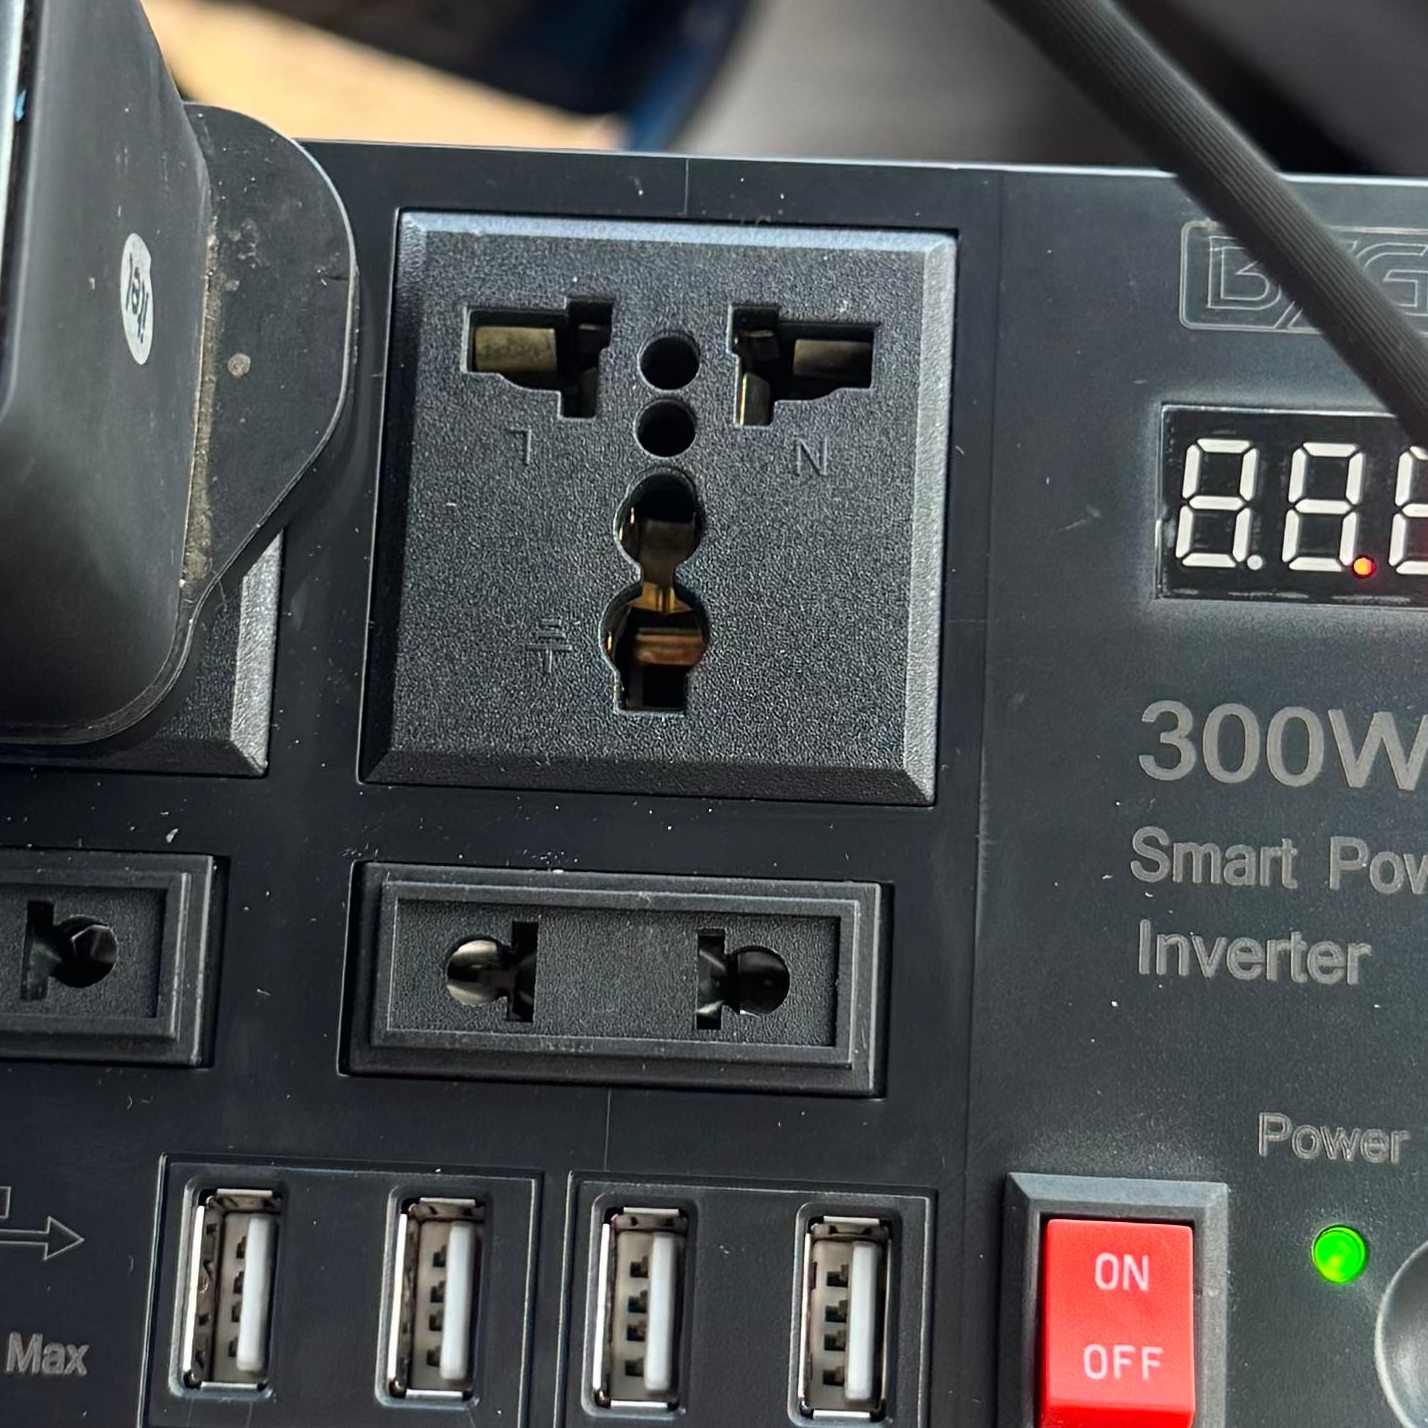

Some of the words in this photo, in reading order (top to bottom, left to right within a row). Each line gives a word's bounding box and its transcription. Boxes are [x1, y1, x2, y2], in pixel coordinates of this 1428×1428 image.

[794, 436, 829, 477] N
[1130, 827, 1299, 890] Smart
[1138, 918, 1373, 986] Inverter
[1257, 1111, 1411, 1164] Power
[1094, 1252, 1151, 1292] ON
[5, 1332, 91, 1377] Max
[1082, 1344, 1165, 1381] OFF
